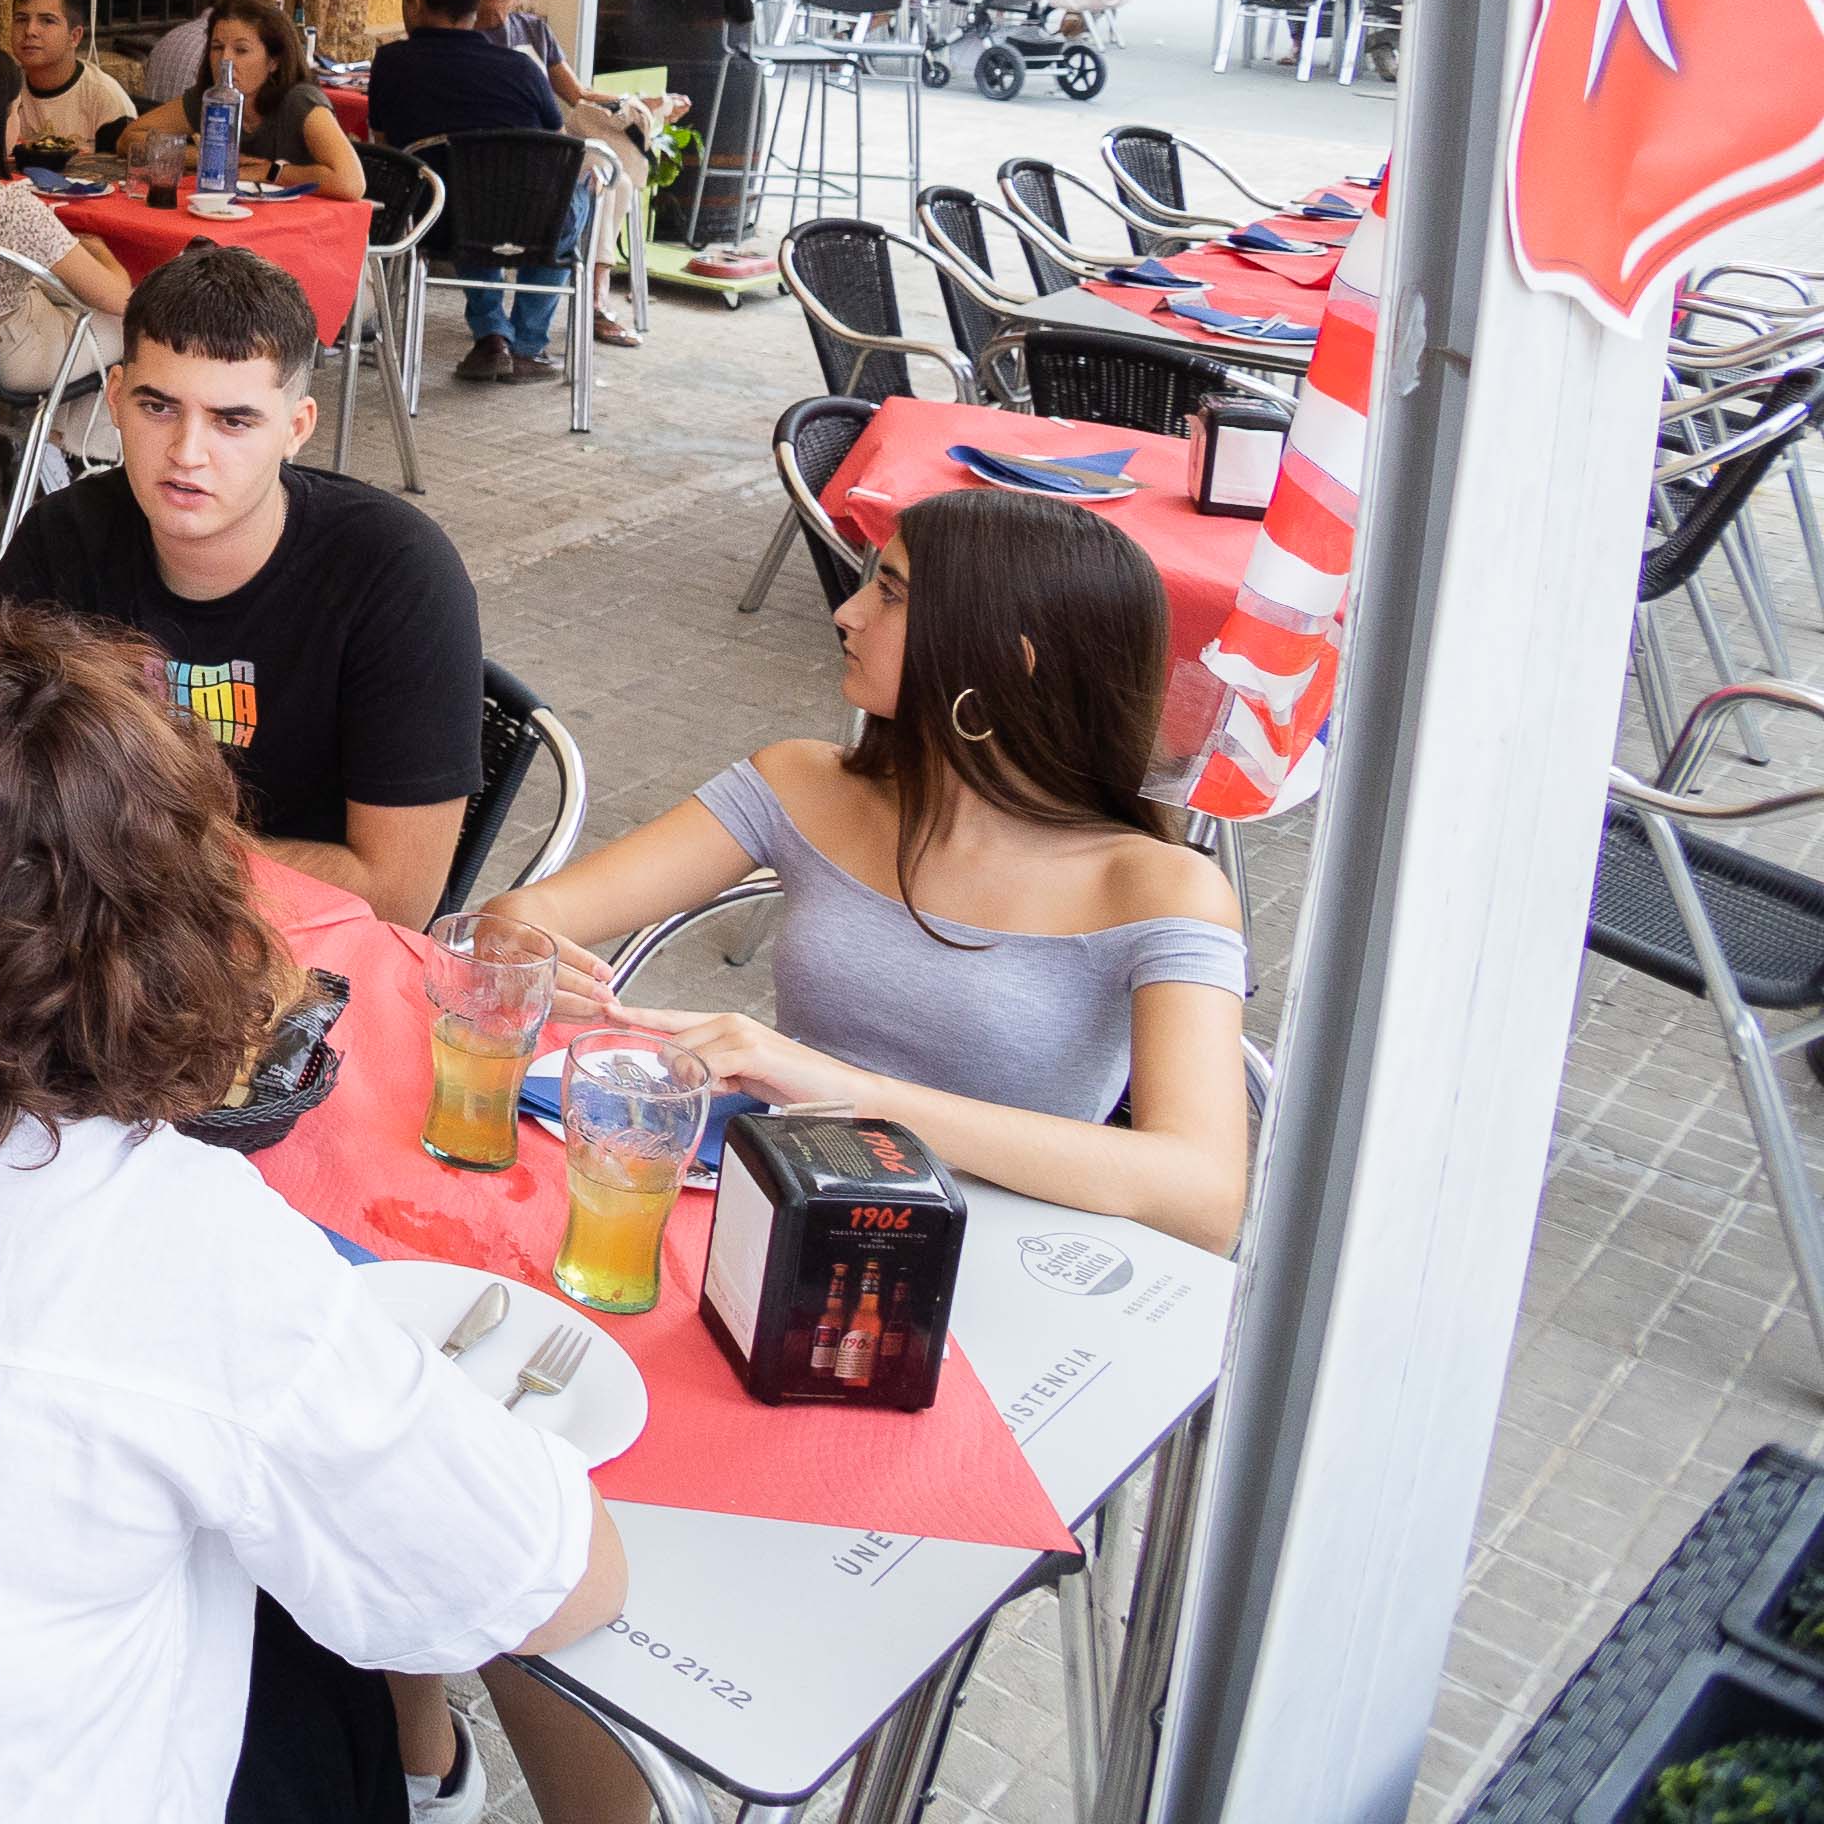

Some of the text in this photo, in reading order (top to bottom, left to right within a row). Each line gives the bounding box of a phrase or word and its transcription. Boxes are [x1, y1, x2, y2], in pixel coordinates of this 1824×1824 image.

[850, 1206, 913, 1231] 1906
[1036, 1239, 1092, 1278] Estrella
[1061, 1252, 1116, 1287] Galicia
[832, 1529, 894, 1577] ÚNE
